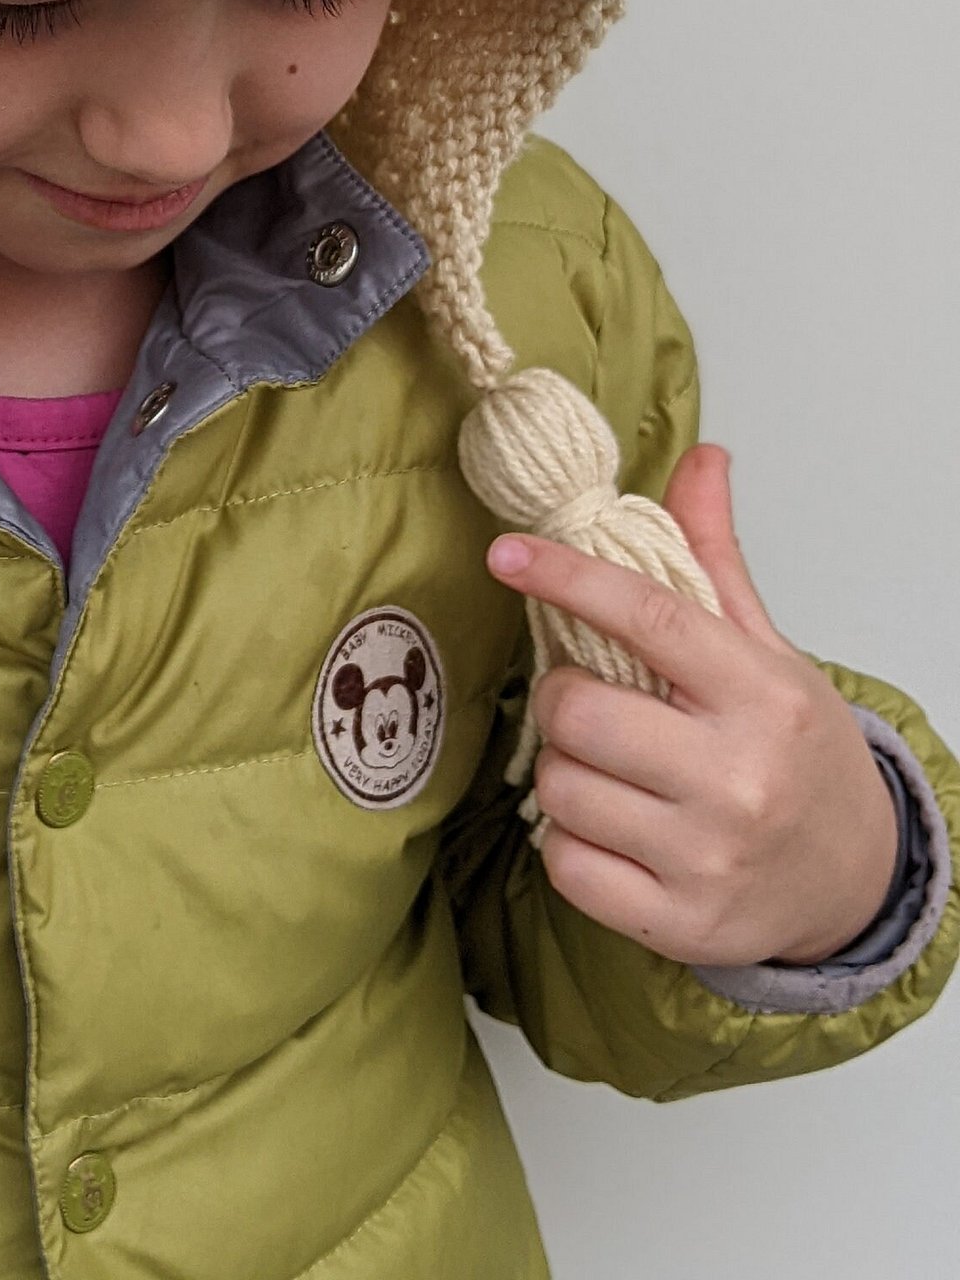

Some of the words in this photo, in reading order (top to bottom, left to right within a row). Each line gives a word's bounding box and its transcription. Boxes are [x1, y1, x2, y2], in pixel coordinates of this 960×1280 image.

[340, 631, 367, 660] BABY
[377, 623, 418, 645] MICKEY
[344, 755, 371, 788] VERY
[373, 770, 409, 792] HAPPY
[410, 717, 432, 769] TODAY
